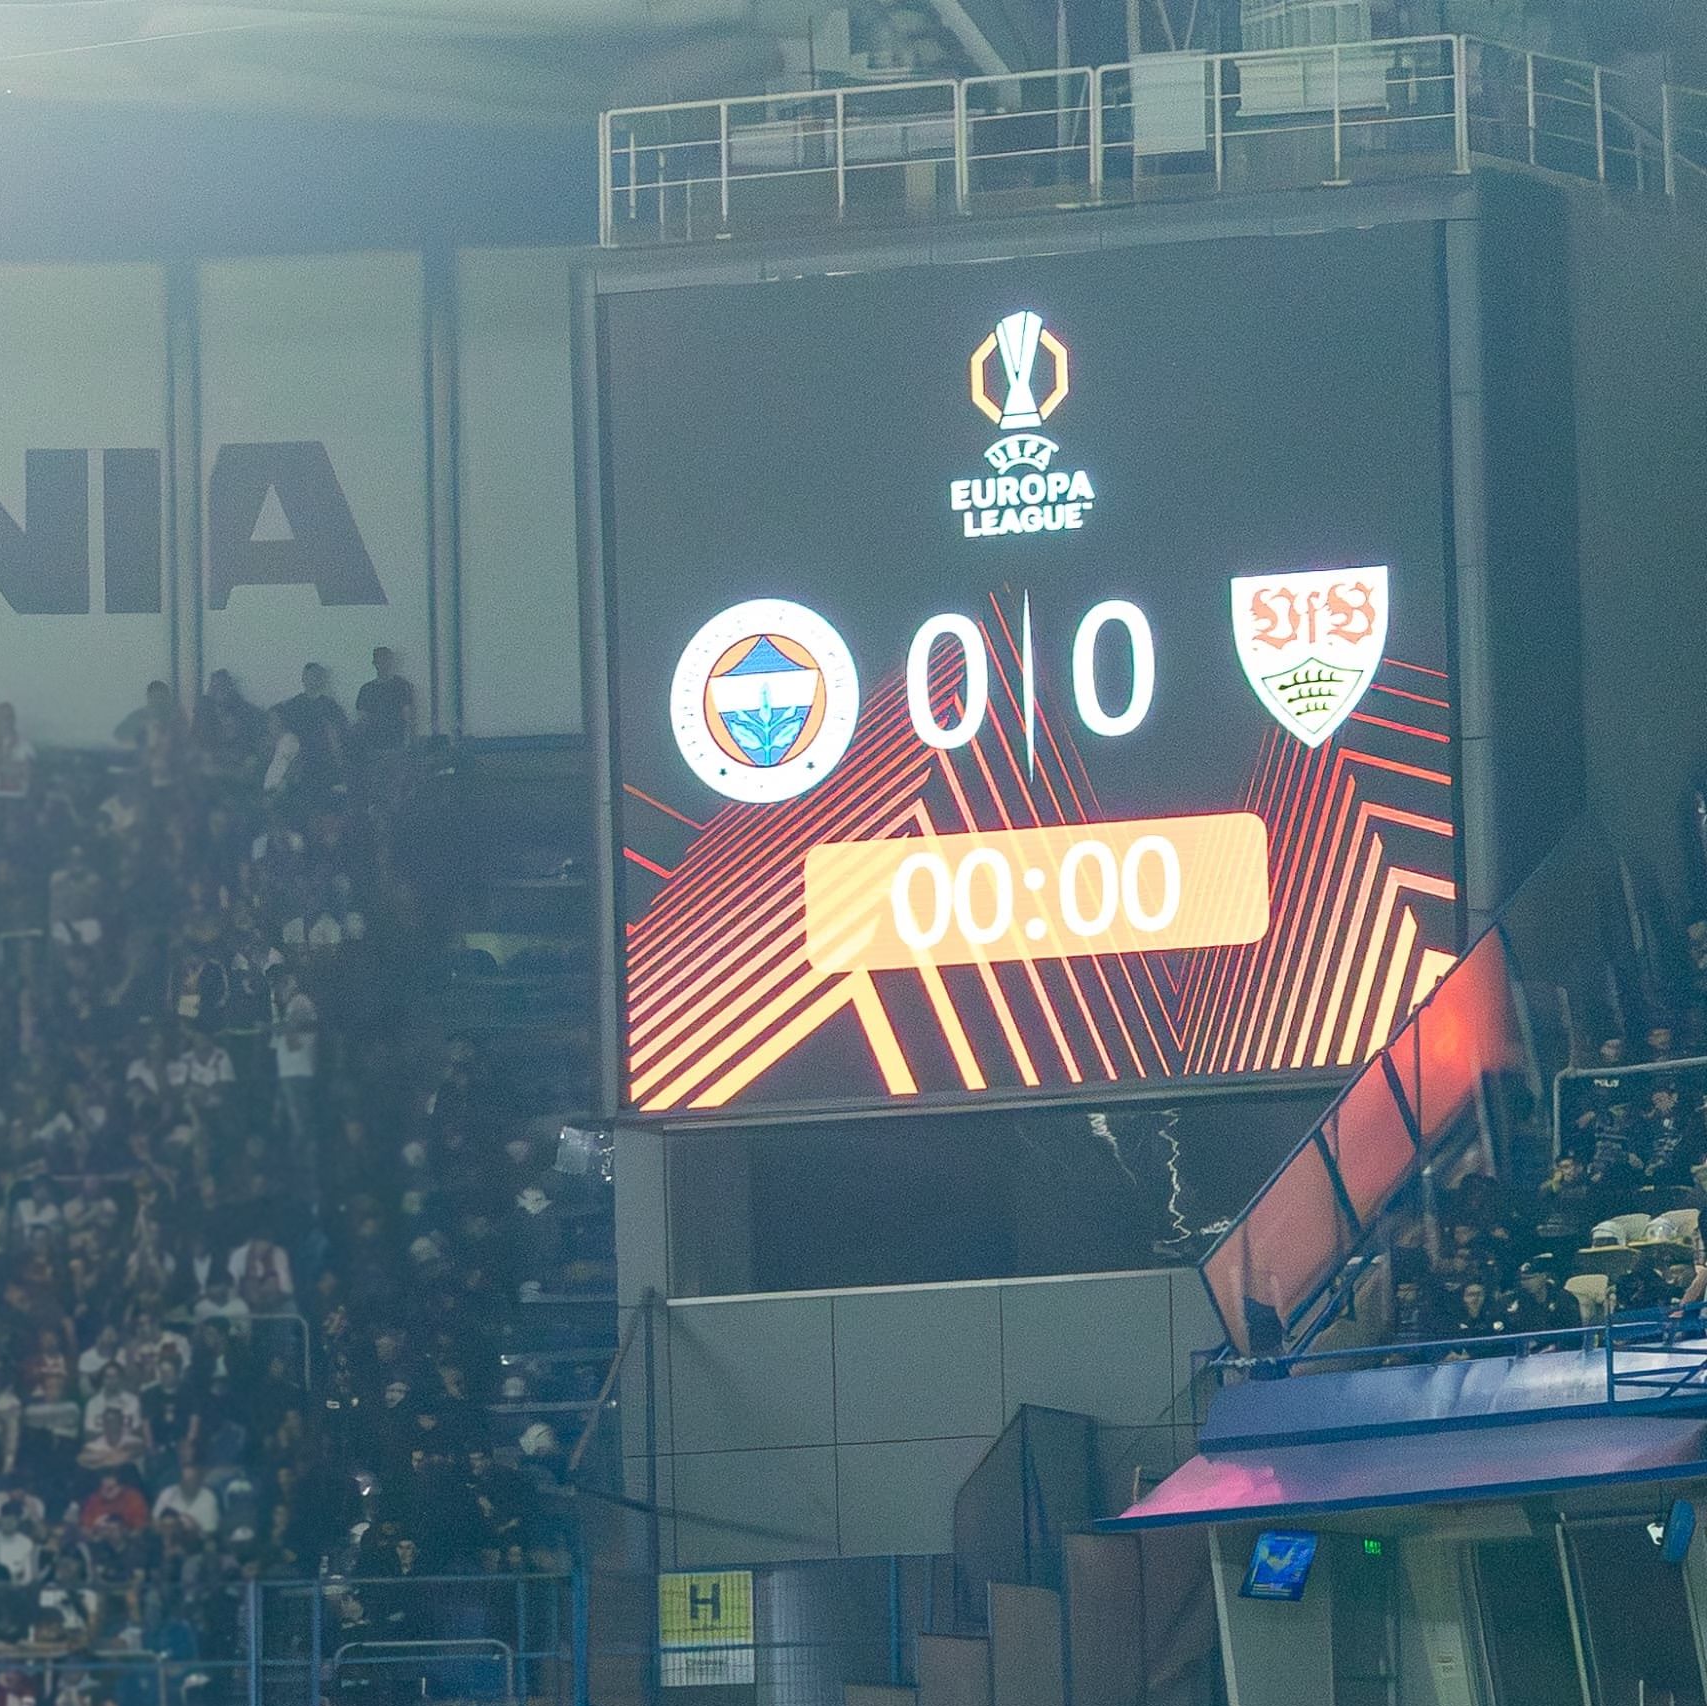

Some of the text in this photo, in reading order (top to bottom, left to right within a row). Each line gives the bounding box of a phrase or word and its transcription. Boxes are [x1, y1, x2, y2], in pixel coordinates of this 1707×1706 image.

[950, 470, 1095, 511] EUROPA
[905, 612, 989, 750] 0
[1071, 600, 1157, 738] 0
[890, 833, 1183, 951] 00:00
[690, 1583, 721, 1621] H
